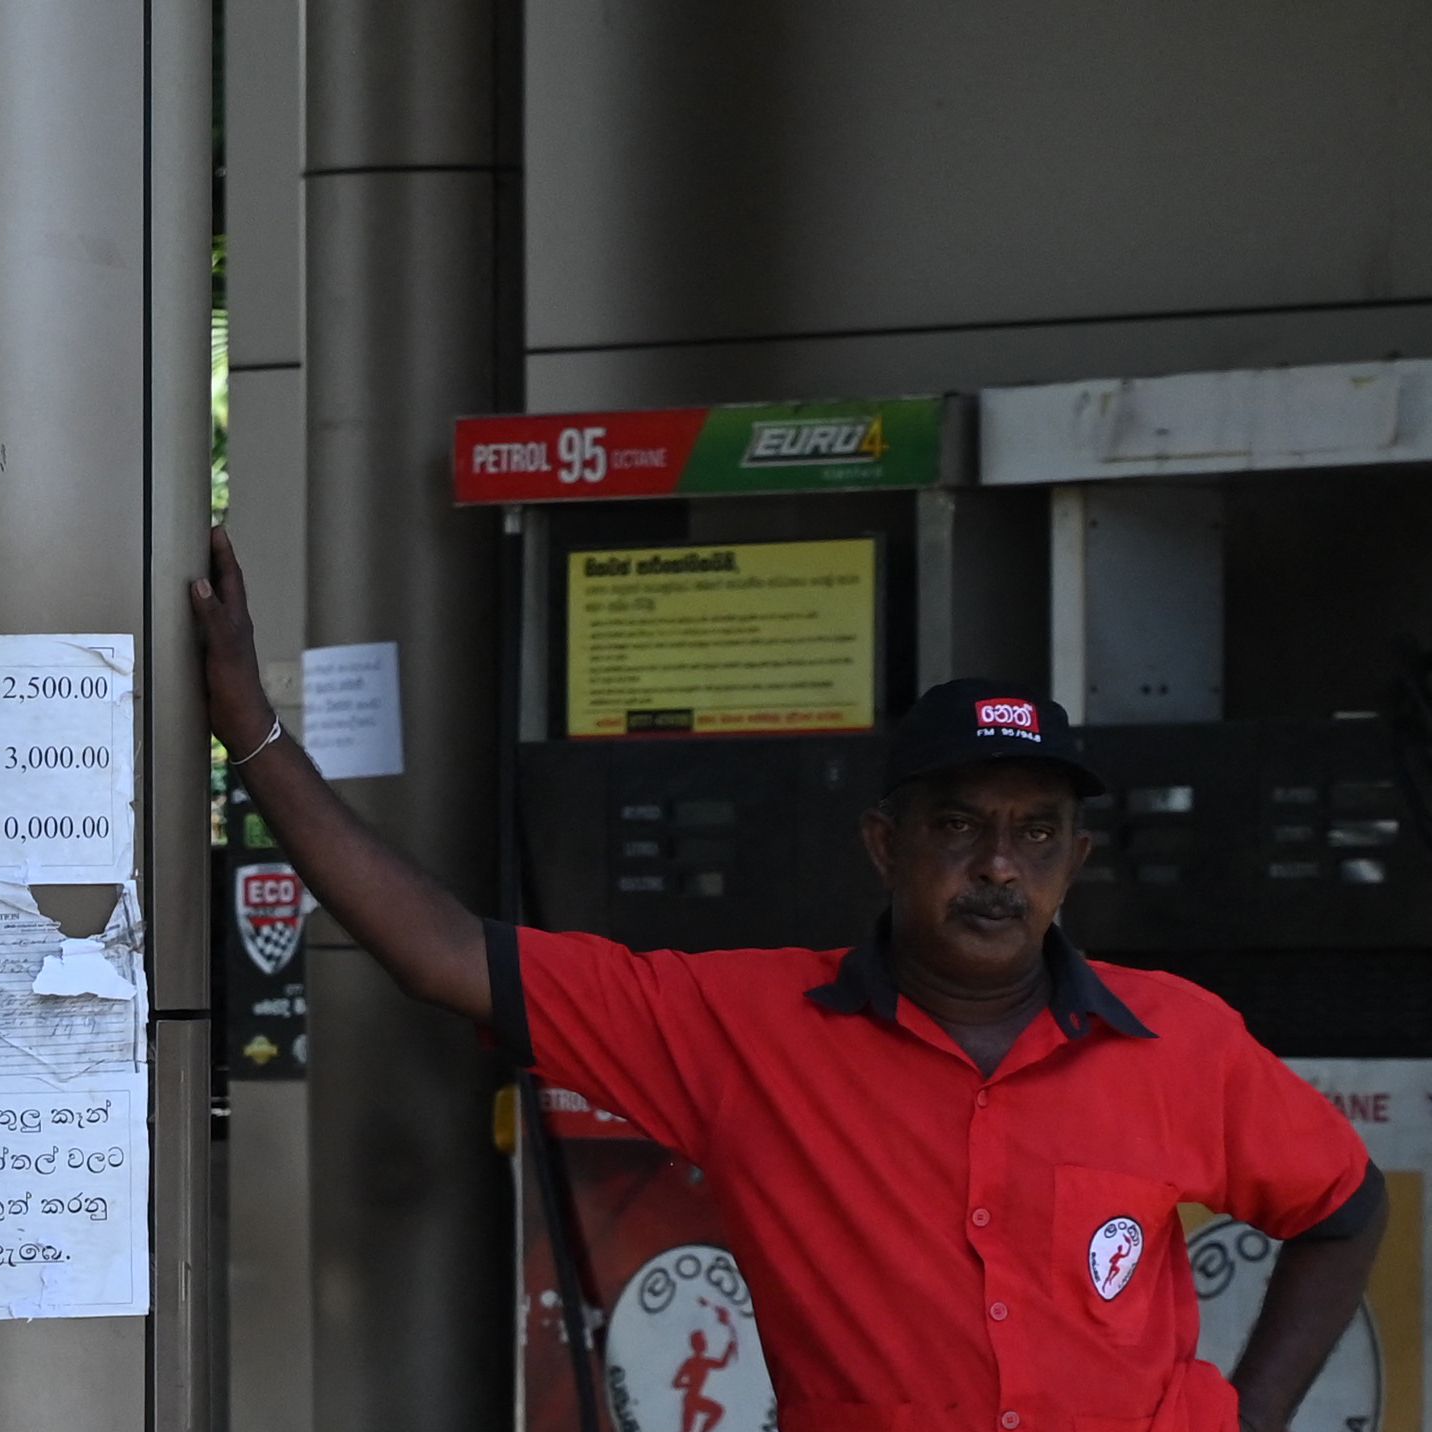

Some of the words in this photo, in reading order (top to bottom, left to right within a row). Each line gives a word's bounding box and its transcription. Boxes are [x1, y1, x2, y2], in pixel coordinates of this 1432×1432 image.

[472, 442, 551, 475] PETROL
[557, 426, 608, 484] 95
[611, 448, 668, 470] OCTANE
[2, 675, 109, 701] 2,500.00
[976, 728, 996, 737] FM
[4, 745, 110, 774] 3,000.00
[248, 878, 296, 904] ECO
[67, 1146, 125, 1174] වලට
[40, 1191, 109, 1221] කරනු
